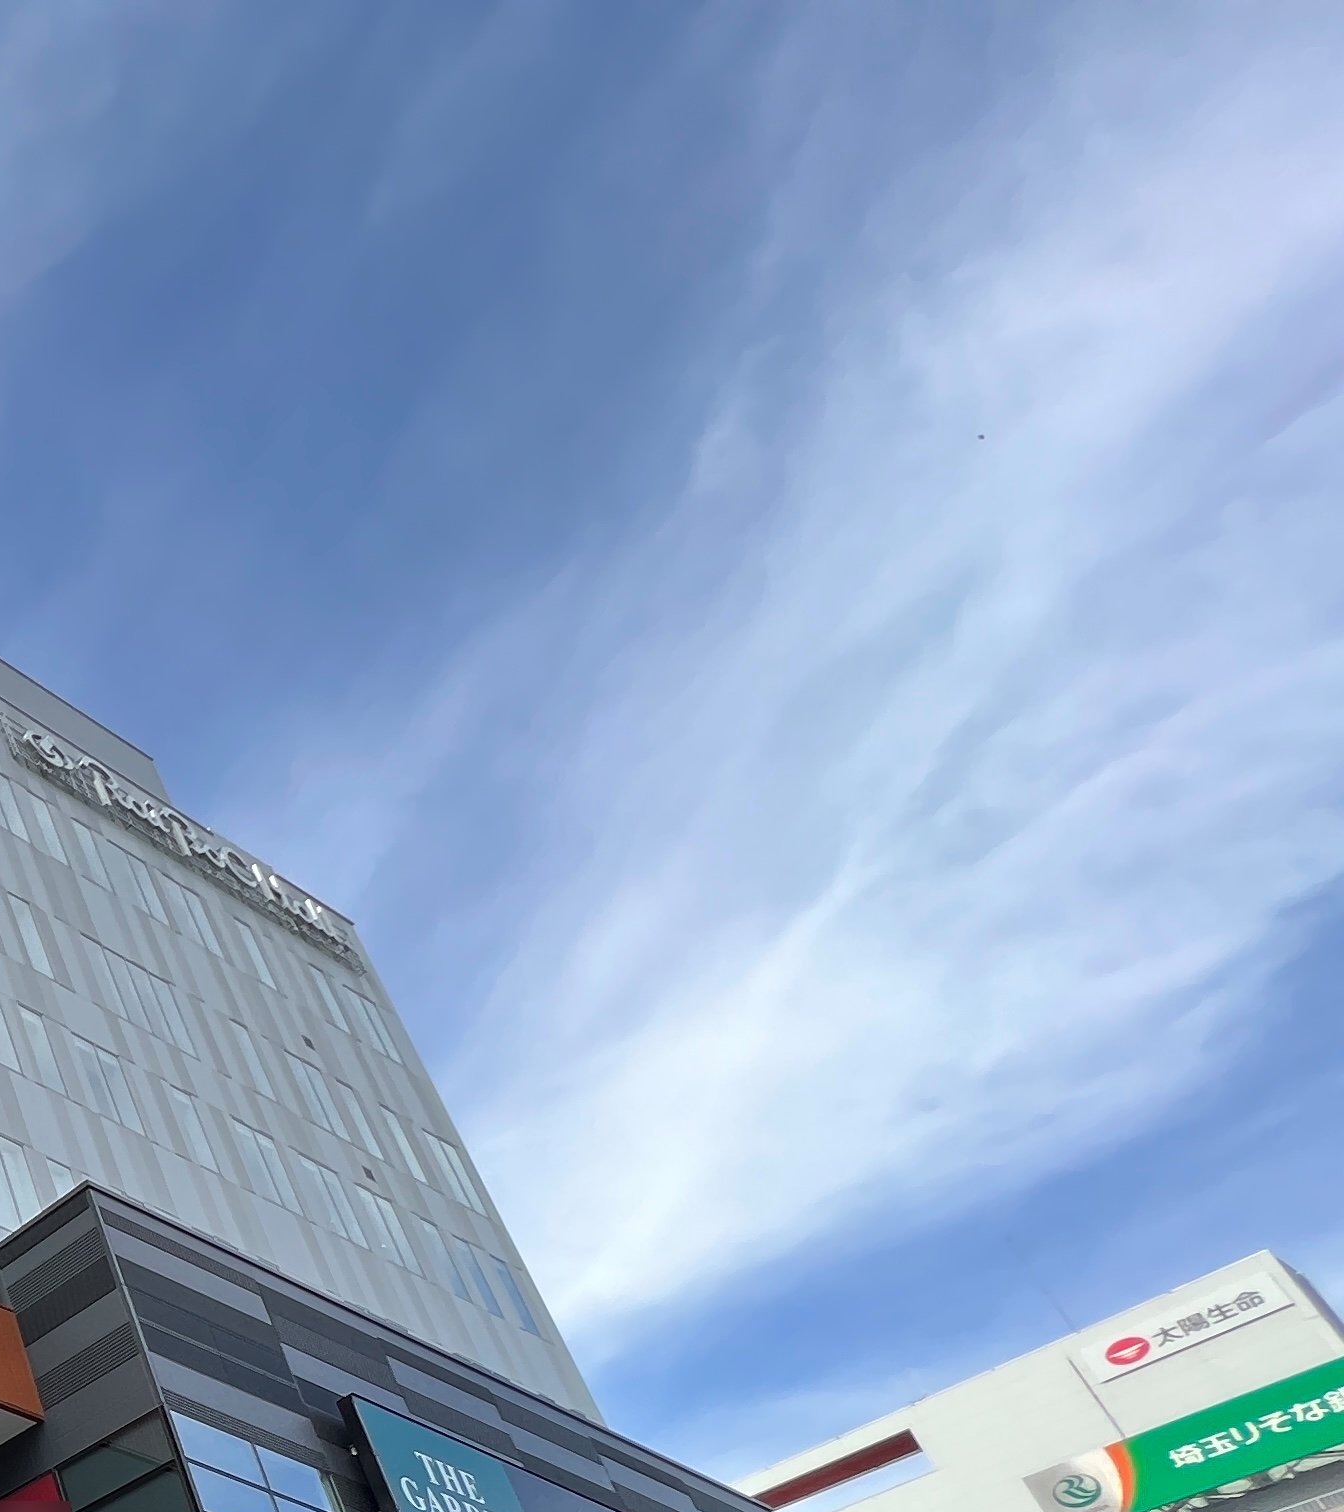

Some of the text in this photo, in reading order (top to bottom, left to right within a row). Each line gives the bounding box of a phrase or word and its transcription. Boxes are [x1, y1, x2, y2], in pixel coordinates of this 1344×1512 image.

[1151, 1290, 1266, 1347] 太陽生命
[413, 1449, 486, 1506] THE
